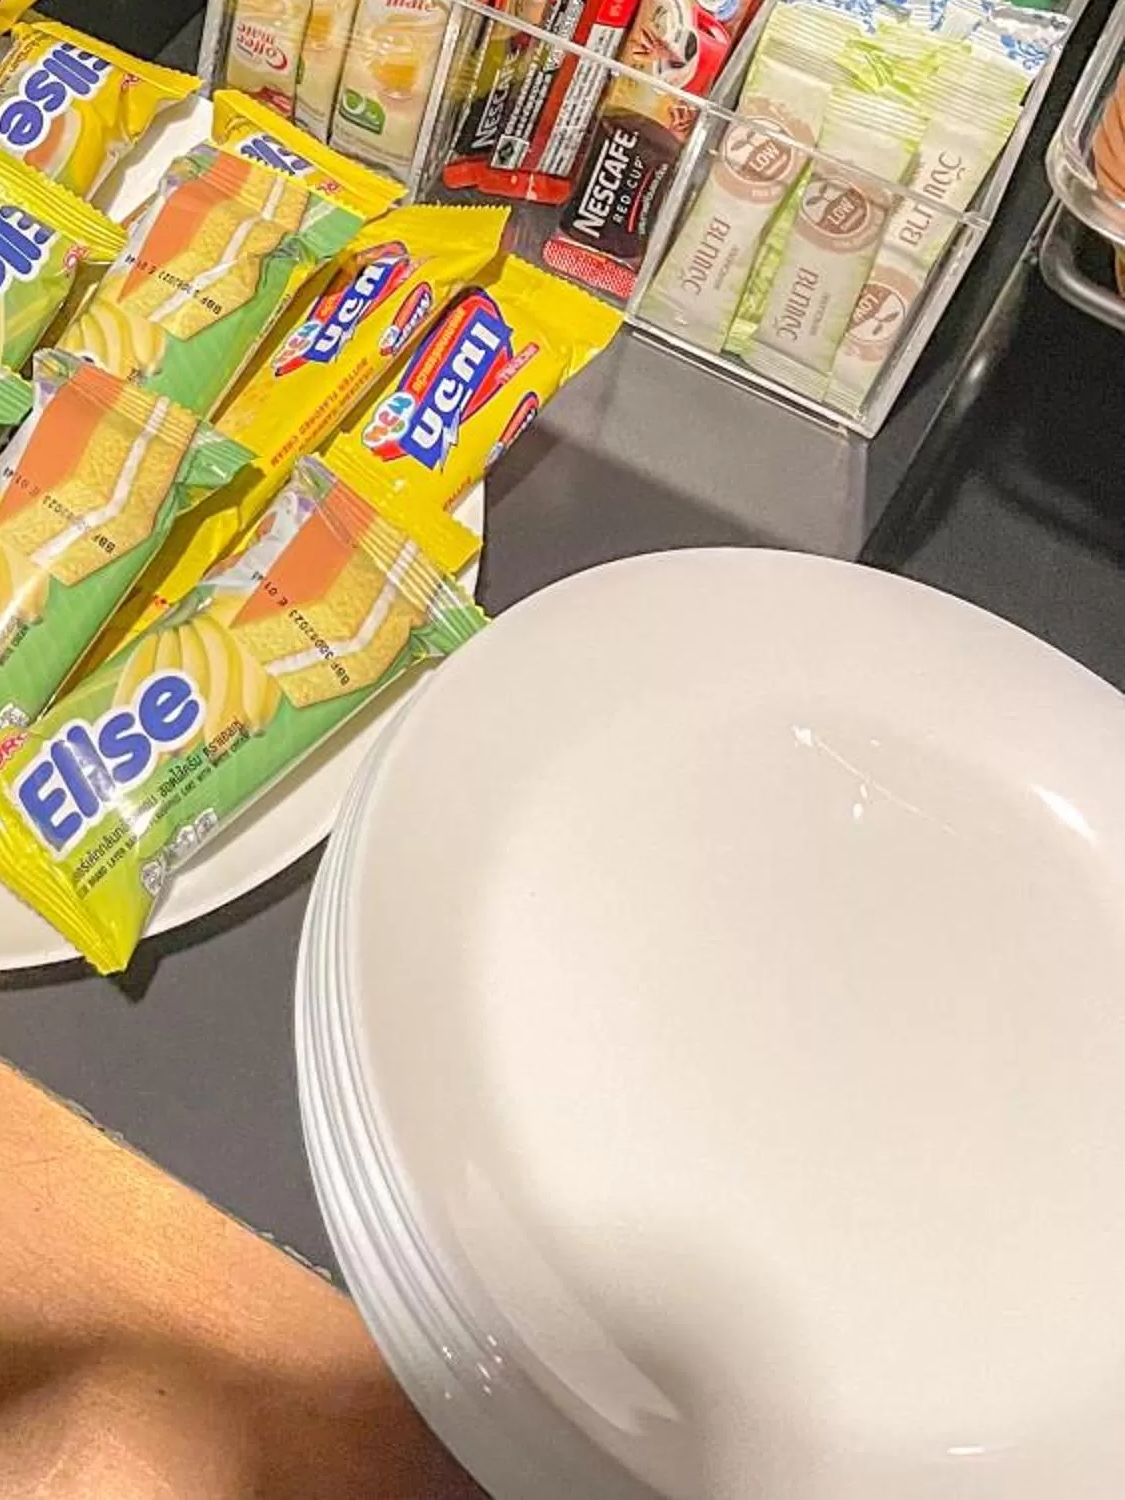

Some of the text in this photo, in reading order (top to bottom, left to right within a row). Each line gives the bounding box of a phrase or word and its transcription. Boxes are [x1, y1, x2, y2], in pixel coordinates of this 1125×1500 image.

[748, 139, 781, 175] LOW
[610, 159, 645, 223] RED CUP
[826, 196, 856, 227] LOW
[19, 675, 200, 852] Ellse
